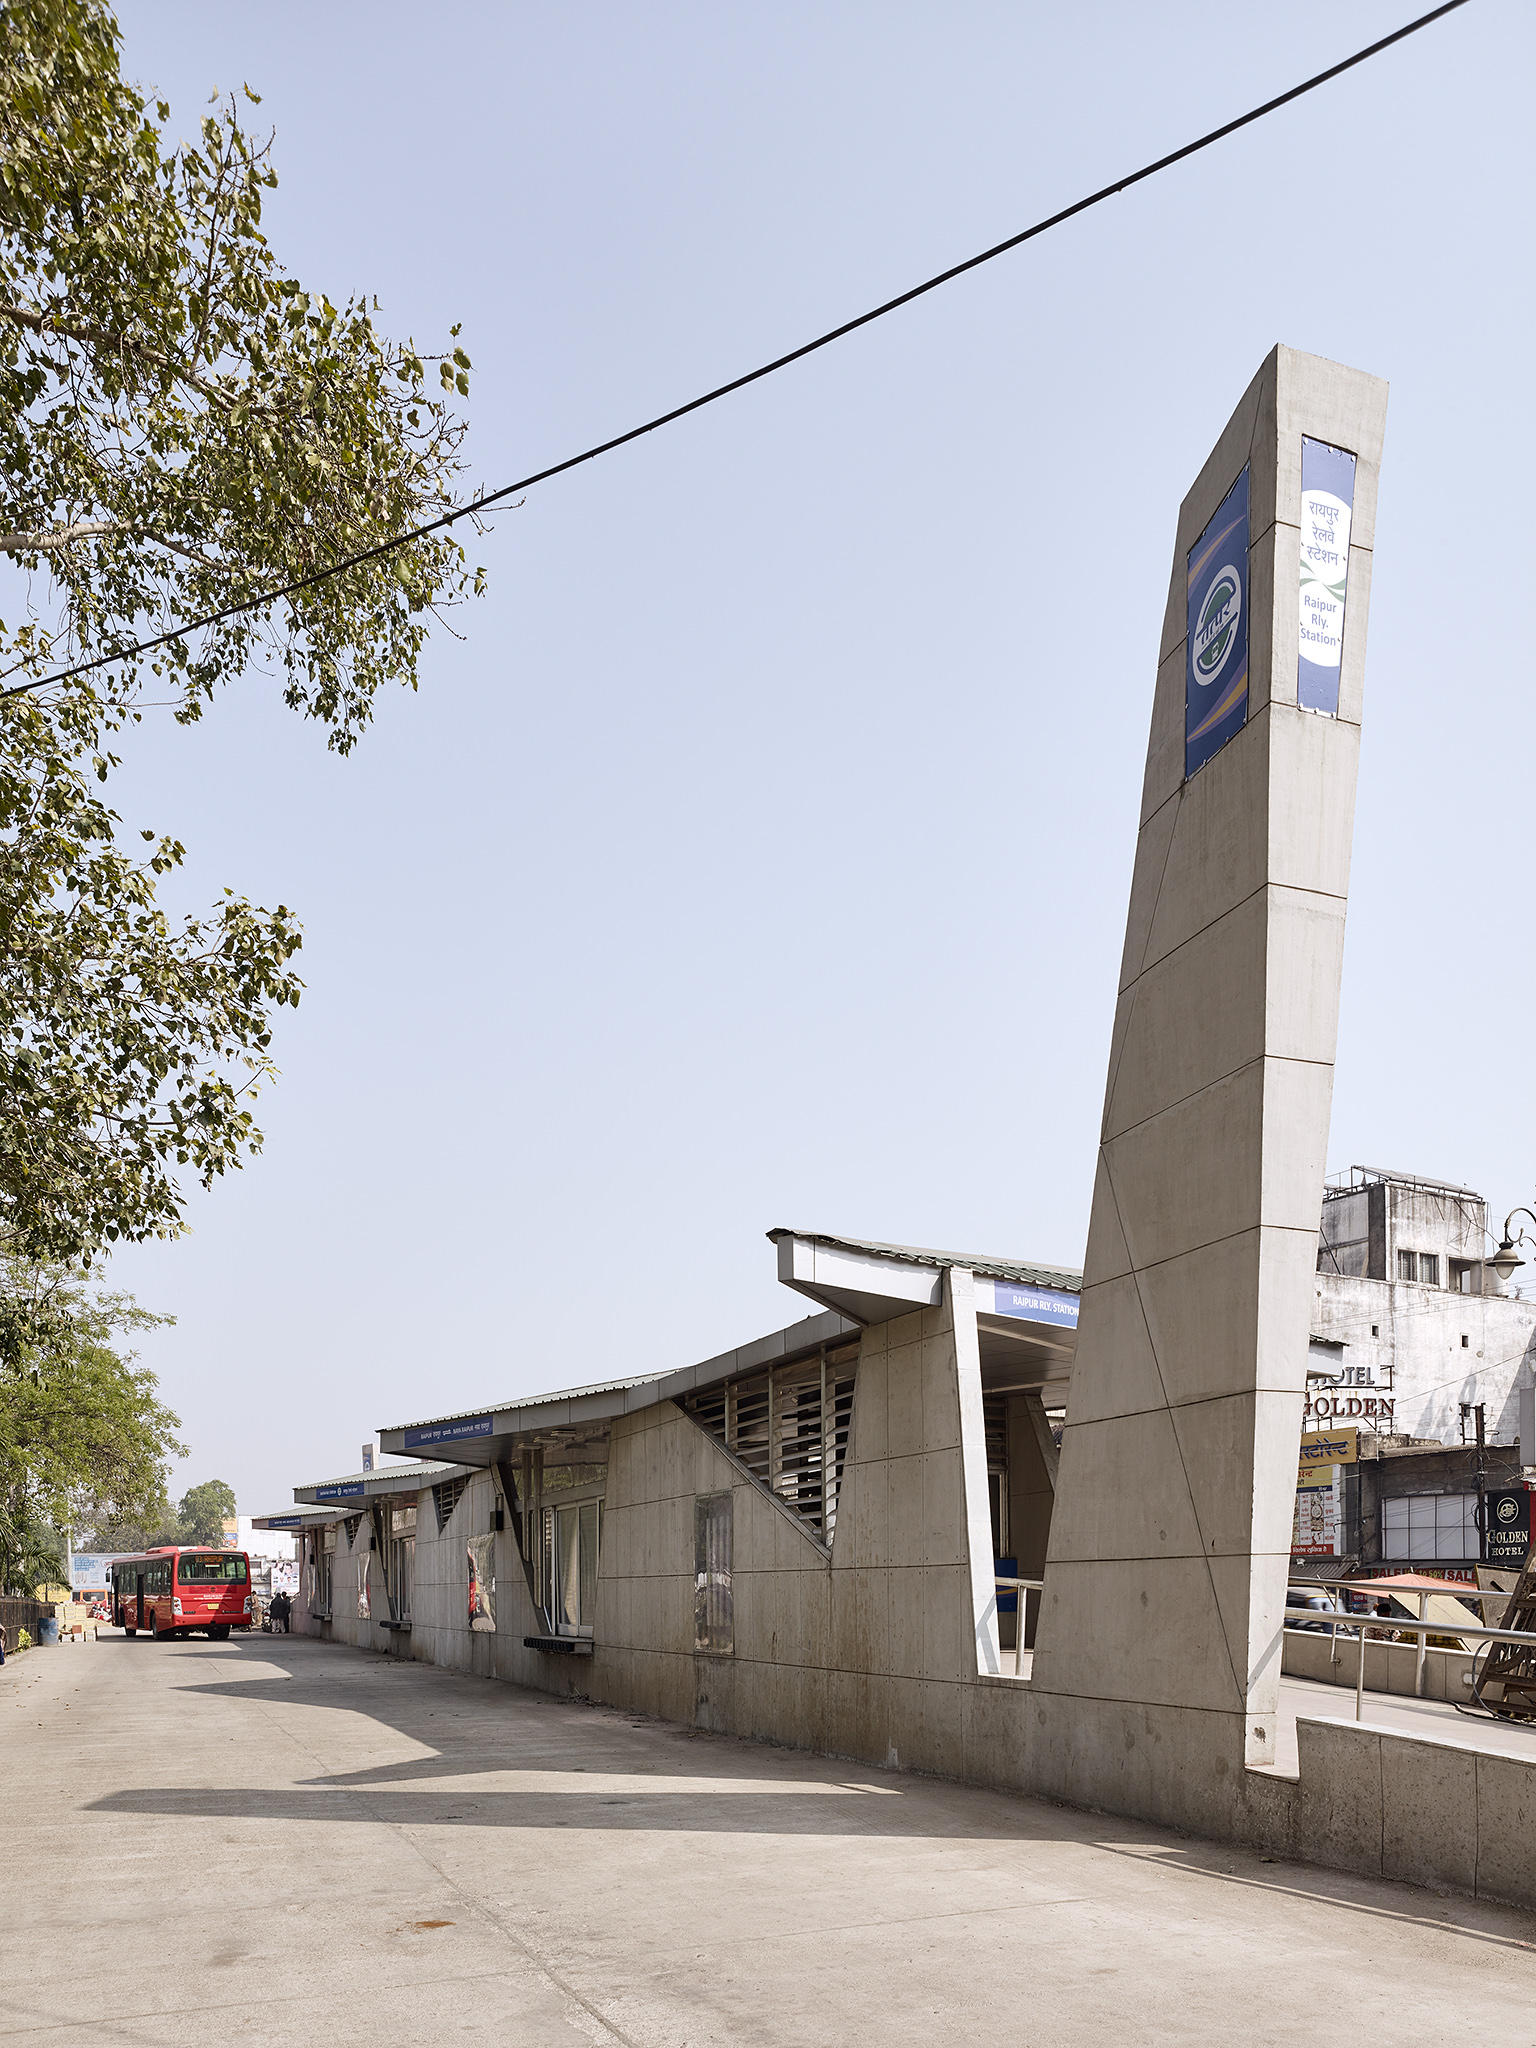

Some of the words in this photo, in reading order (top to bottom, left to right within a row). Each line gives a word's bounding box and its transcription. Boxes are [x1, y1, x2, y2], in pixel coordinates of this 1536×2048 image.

[1309, 501, 1339, 525] रायपुर
[1312, 520, 1335, 544] रेलवे
[1307, 542, 1339, 566] स्टेशन
[1304, 594, 1337, 613] Raipur
[1311, 613, 1329, 630] Rly.
[1300, 627, 1336, 647] Station
[1013, 1296, 1039, 1309] RAIPUR
[1039, 1300, 1052, 1312] RLY.
[1053, 1303, 1079, 1316] STATION
[1313, 1366, 1376, 1385] OTEL
[1488, 1529, 1529, 1544] GOLDEN
[1491, 1547, 1524, 1556] HOTEL
[1372, 1568, 1401, 1578] SALE
[1428, 1569, 1444, 1579] 50%
